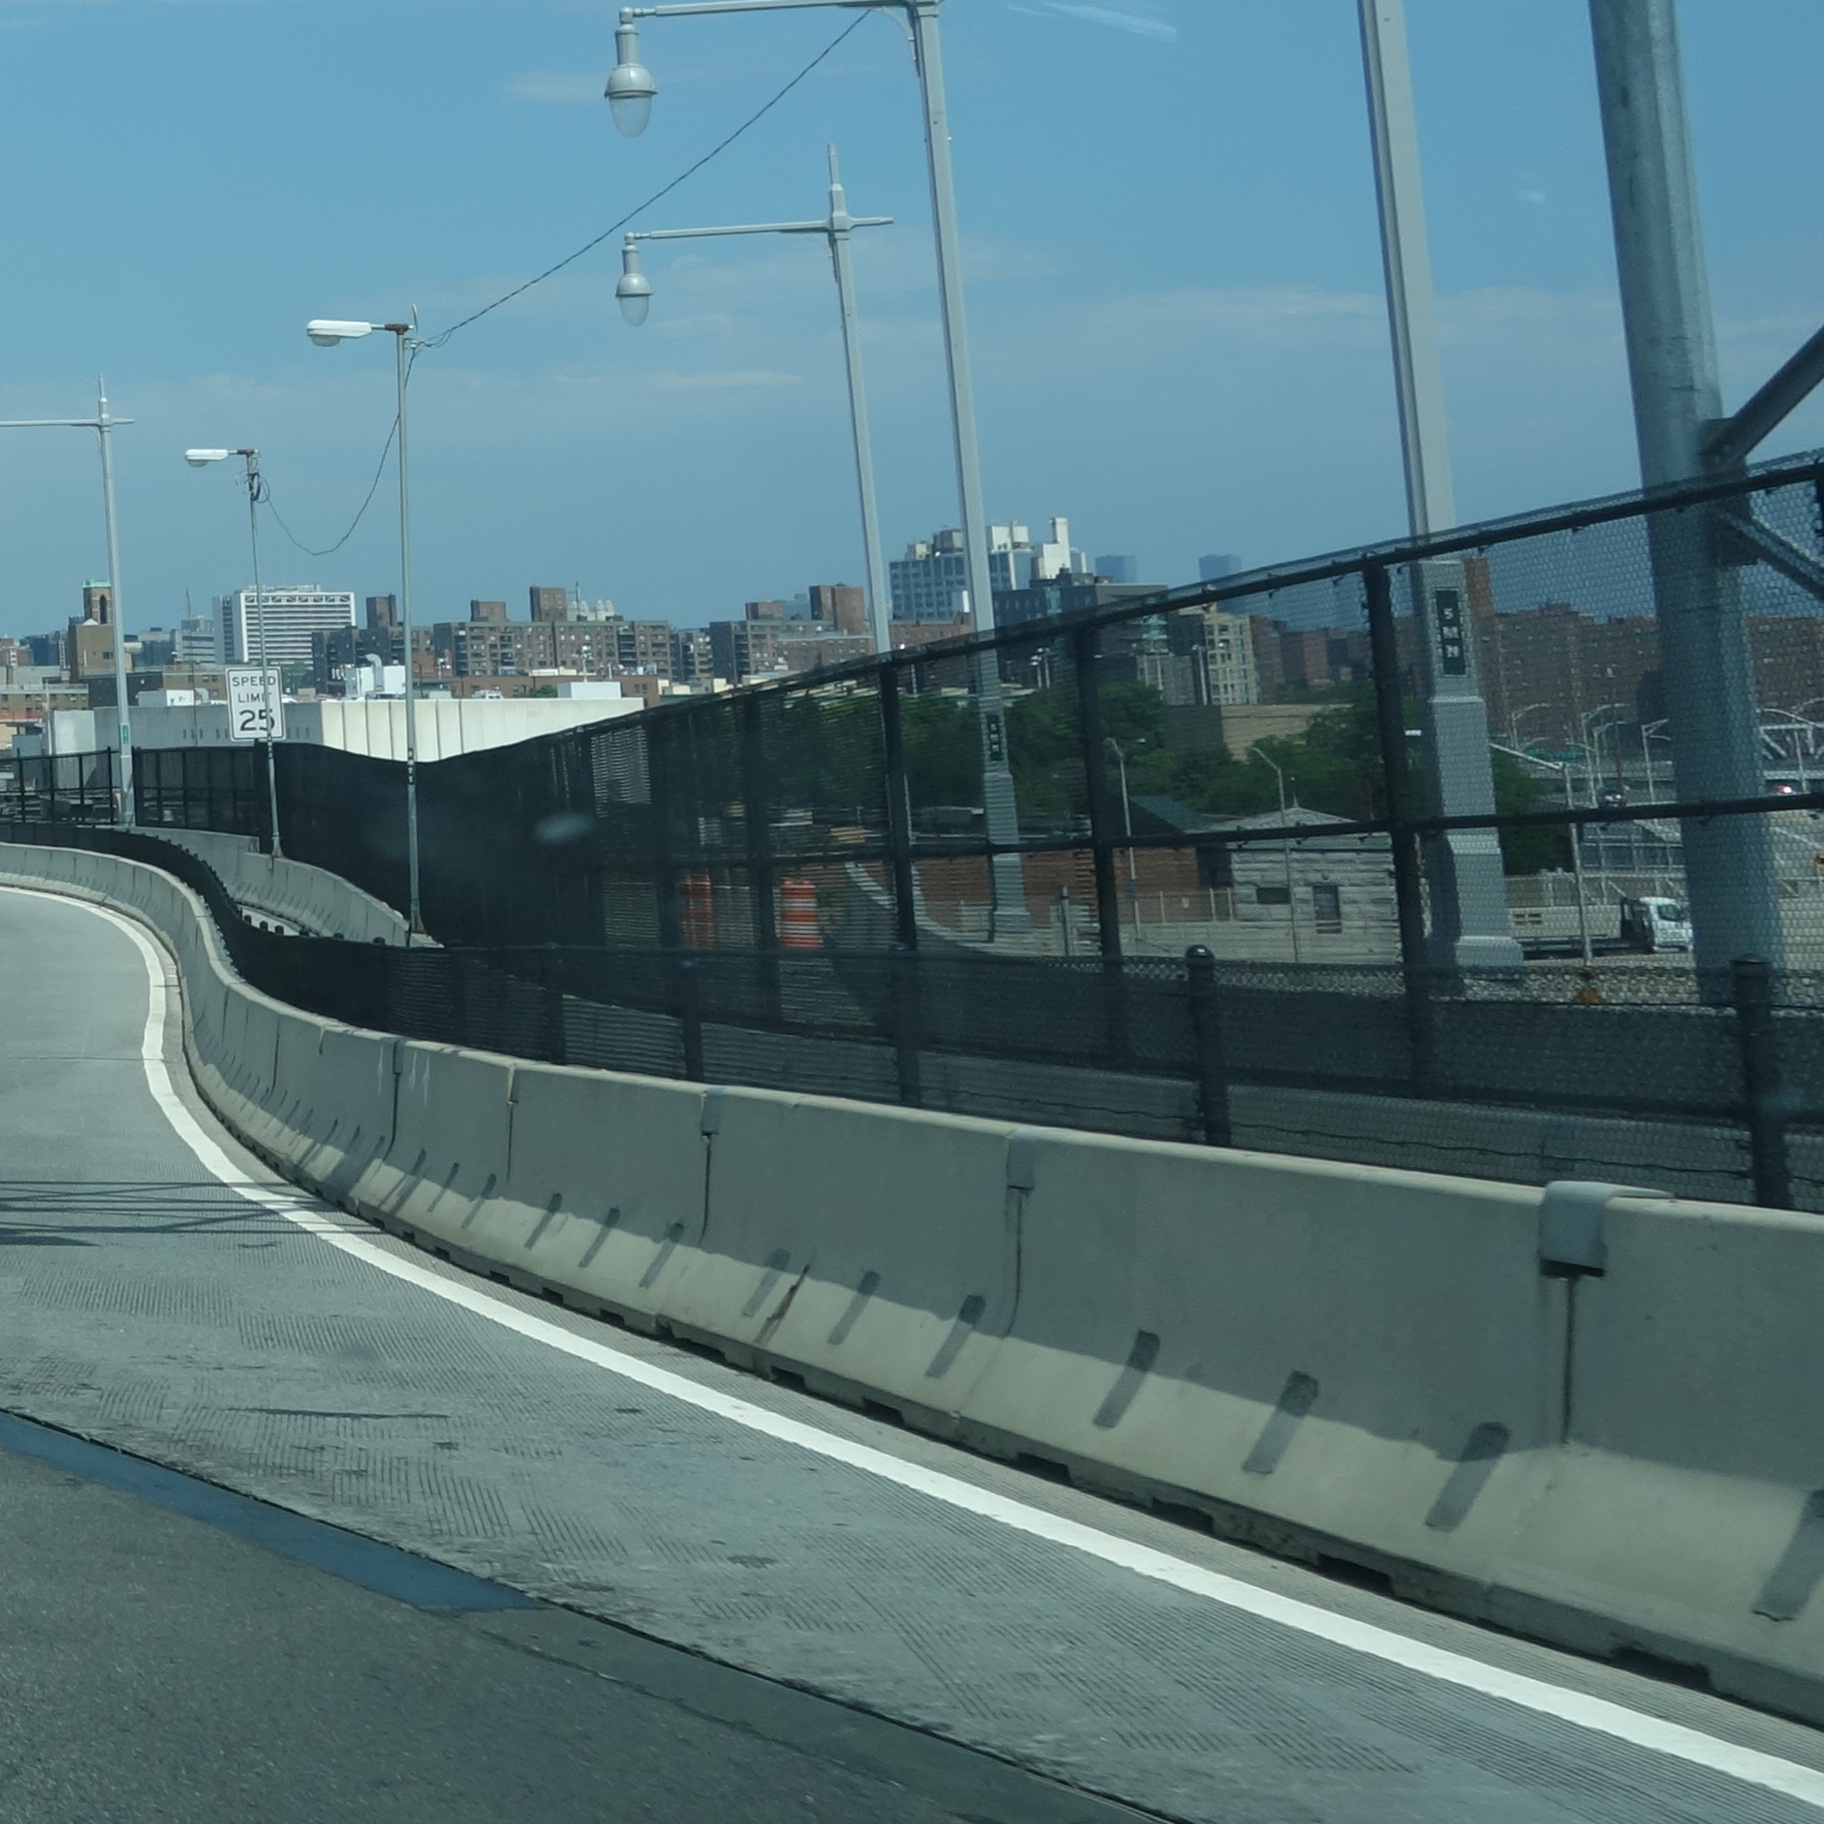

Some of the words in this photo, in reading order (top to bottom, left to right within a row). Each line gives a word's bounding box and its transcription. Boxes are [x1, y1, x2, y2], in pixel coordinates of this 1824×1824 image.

[232, 675, 277, 687] SPEED
[237, 691, 272, 704] LIMI
[239, 708, 275, 732] 25
